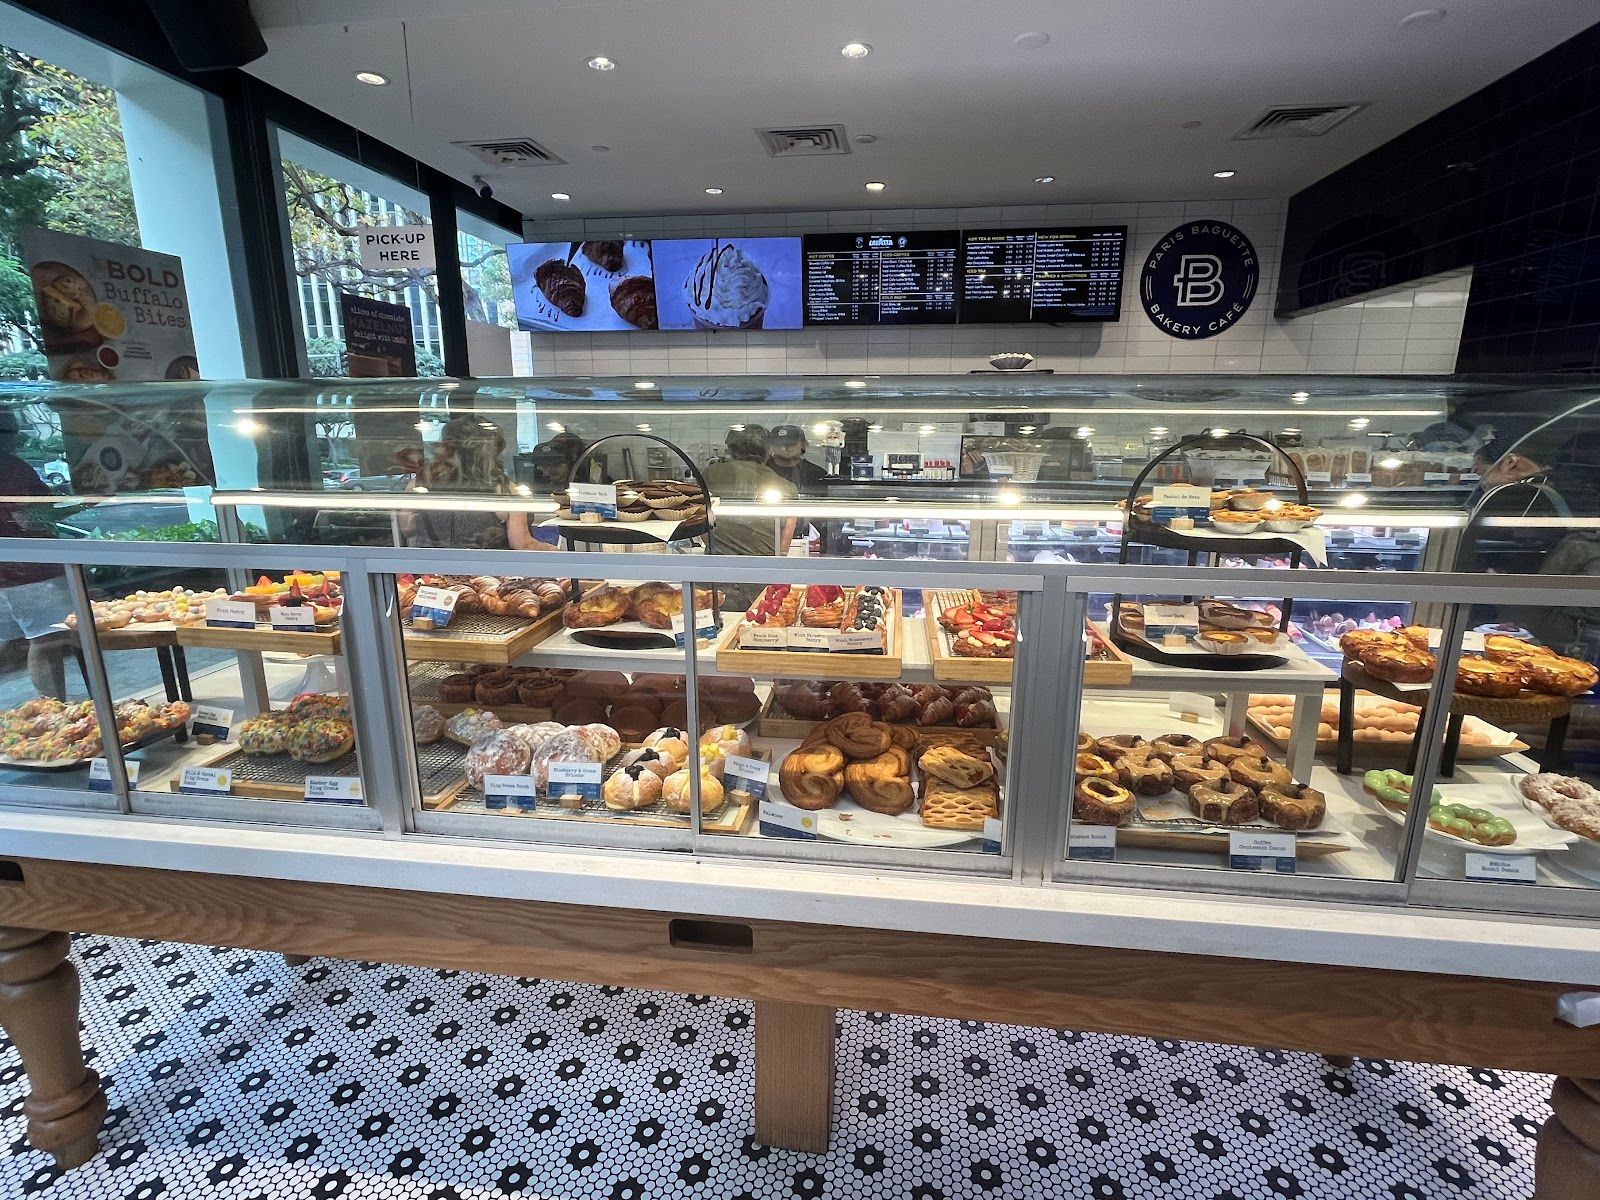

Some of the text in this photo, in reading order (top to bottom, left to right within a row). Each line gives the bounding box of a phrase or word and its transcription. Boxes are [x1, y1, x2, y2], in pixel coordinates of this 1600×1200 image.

[366, 233, 426, 245] PICK-UP
[1149, 231, 1184, 269] PARIS
[1191, 225, 1254, 268] BAGUETTE
[380, 250, 420, 261] HERE
[107, 260, 179, 288] BOLD
[102, 282, 183, 309] Buffalo
[133, 305, 186, 328] Bites
[1150, 303, 1201, 335] BAKERY
